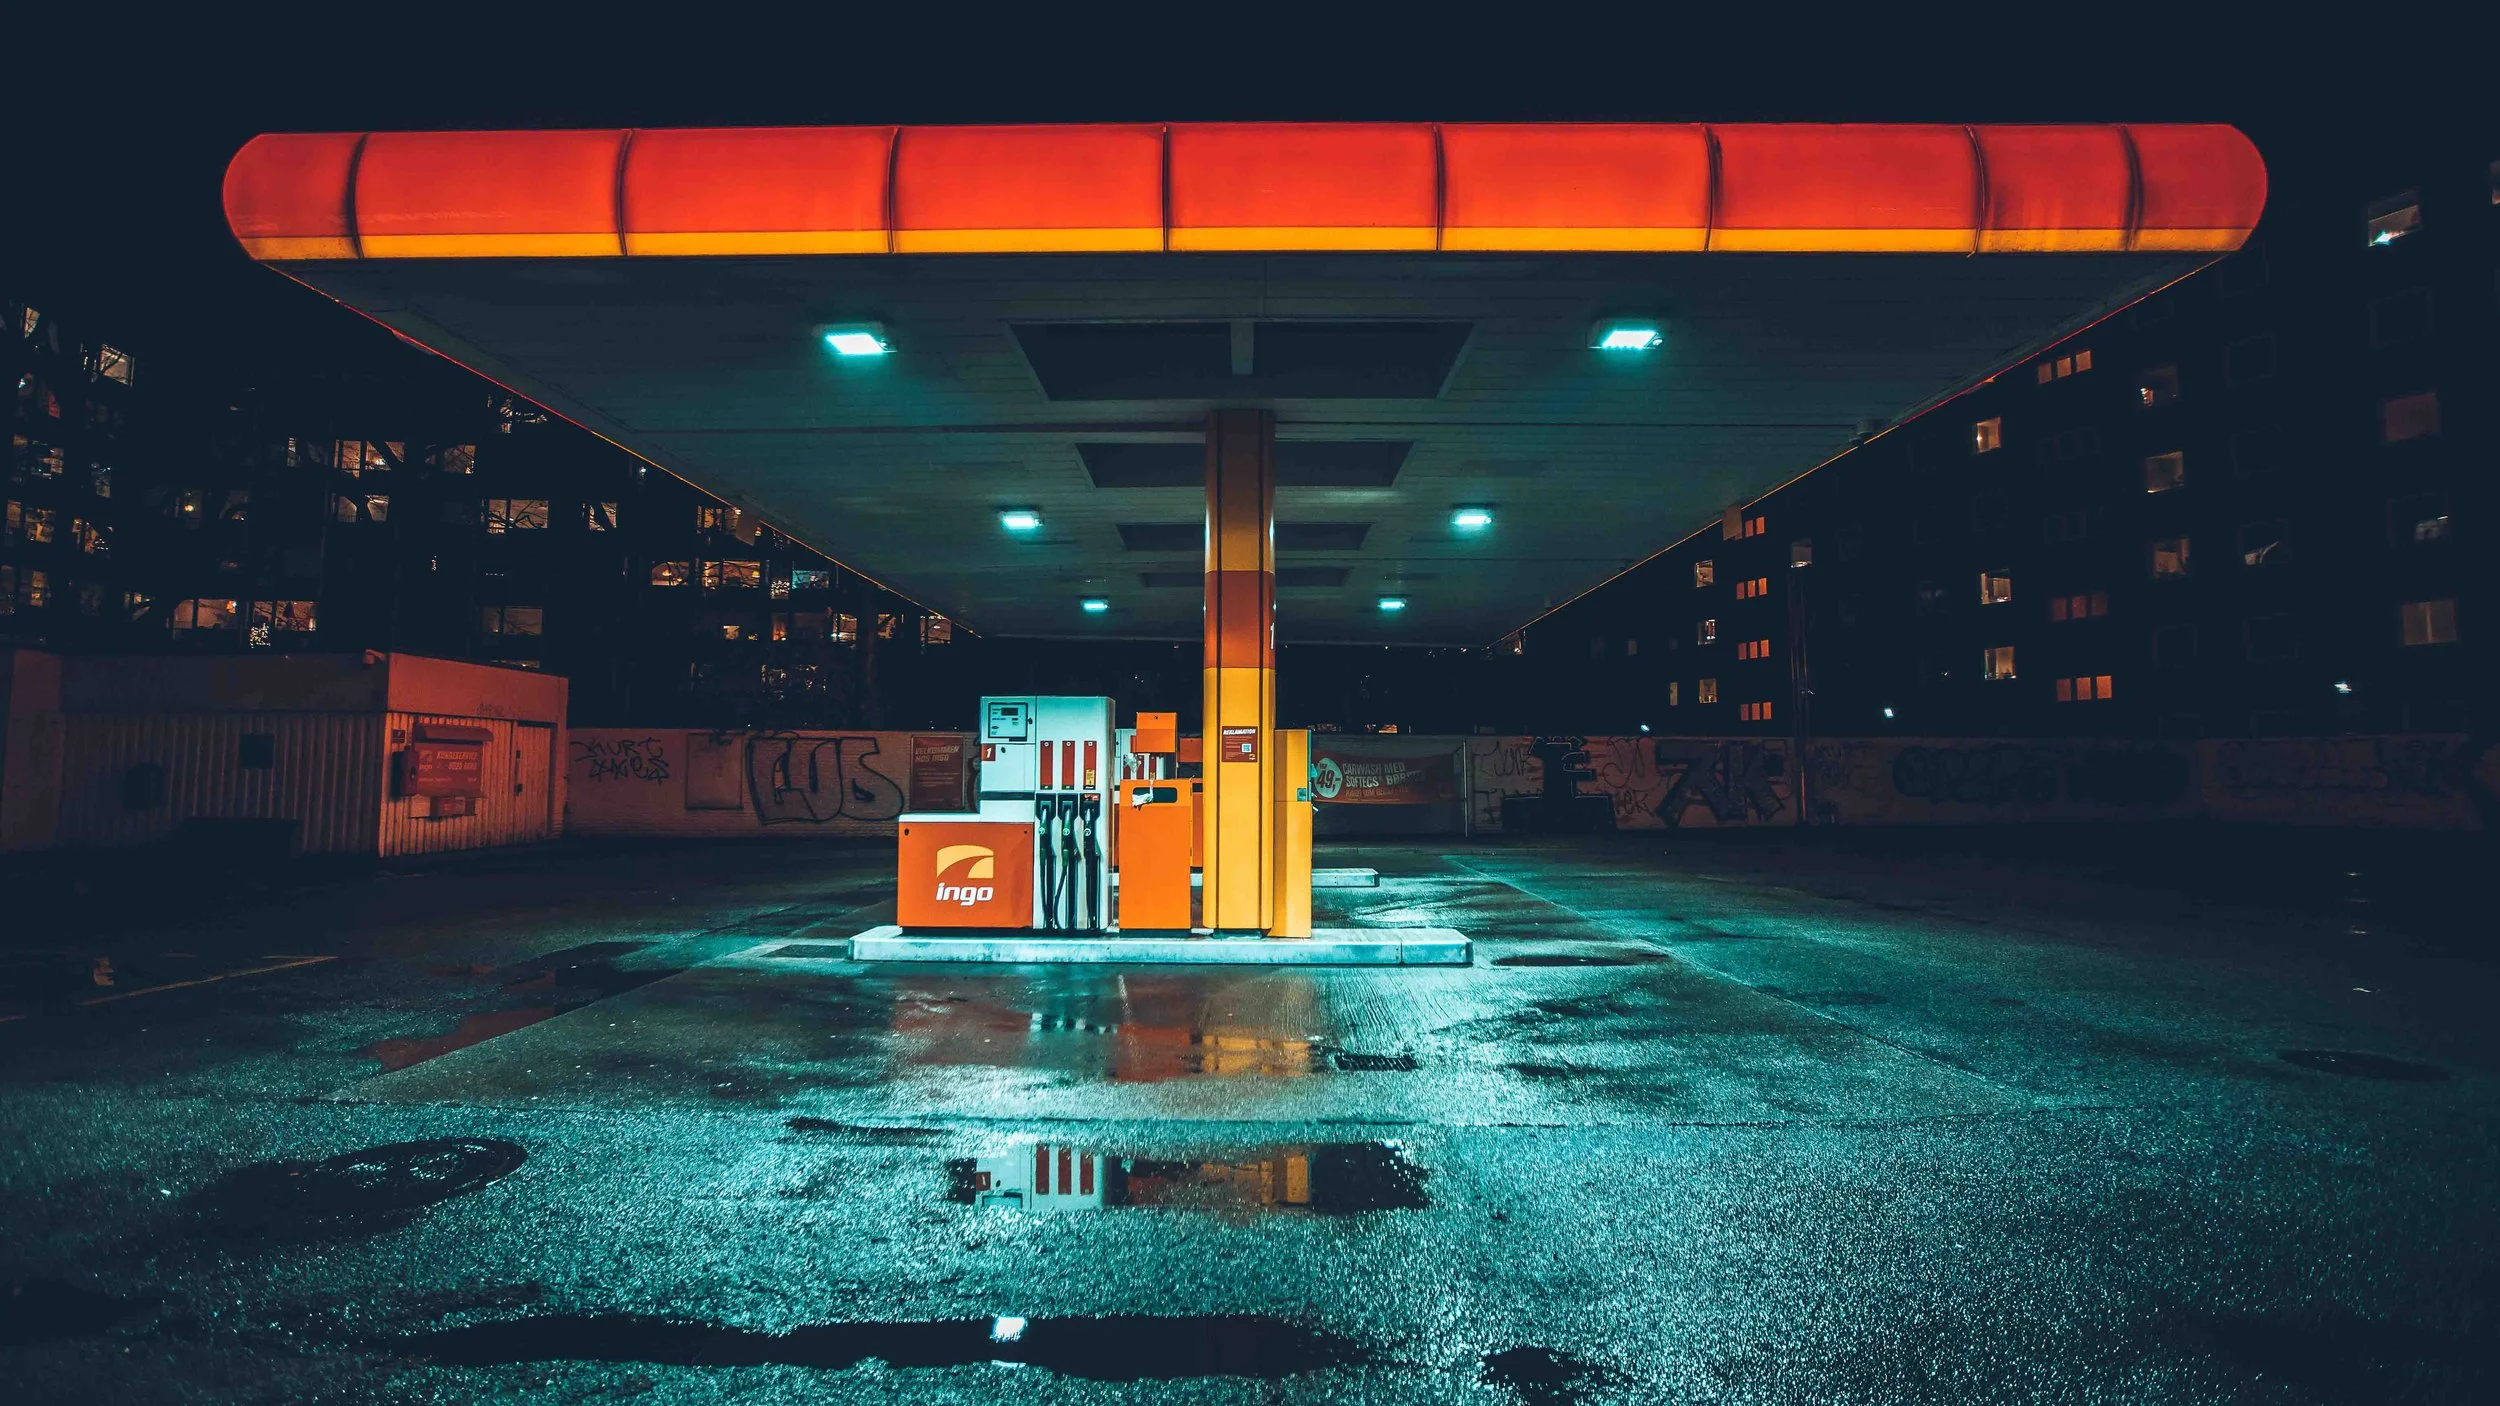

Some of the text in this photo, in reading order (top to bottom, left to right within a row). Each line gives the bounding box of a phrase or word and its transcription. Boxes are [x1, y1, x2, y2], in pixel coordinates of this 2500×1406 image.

[915, 745, 960, 755] VELKOMMEN
[986, 747, 992, 759] 1
[1342, 763, 1382, 775] CARWASH
[1384, 761, 1405, 774] MED
[1316, 769, 1341, 793] 49,-
[936, 882, 994, 906] ingo
